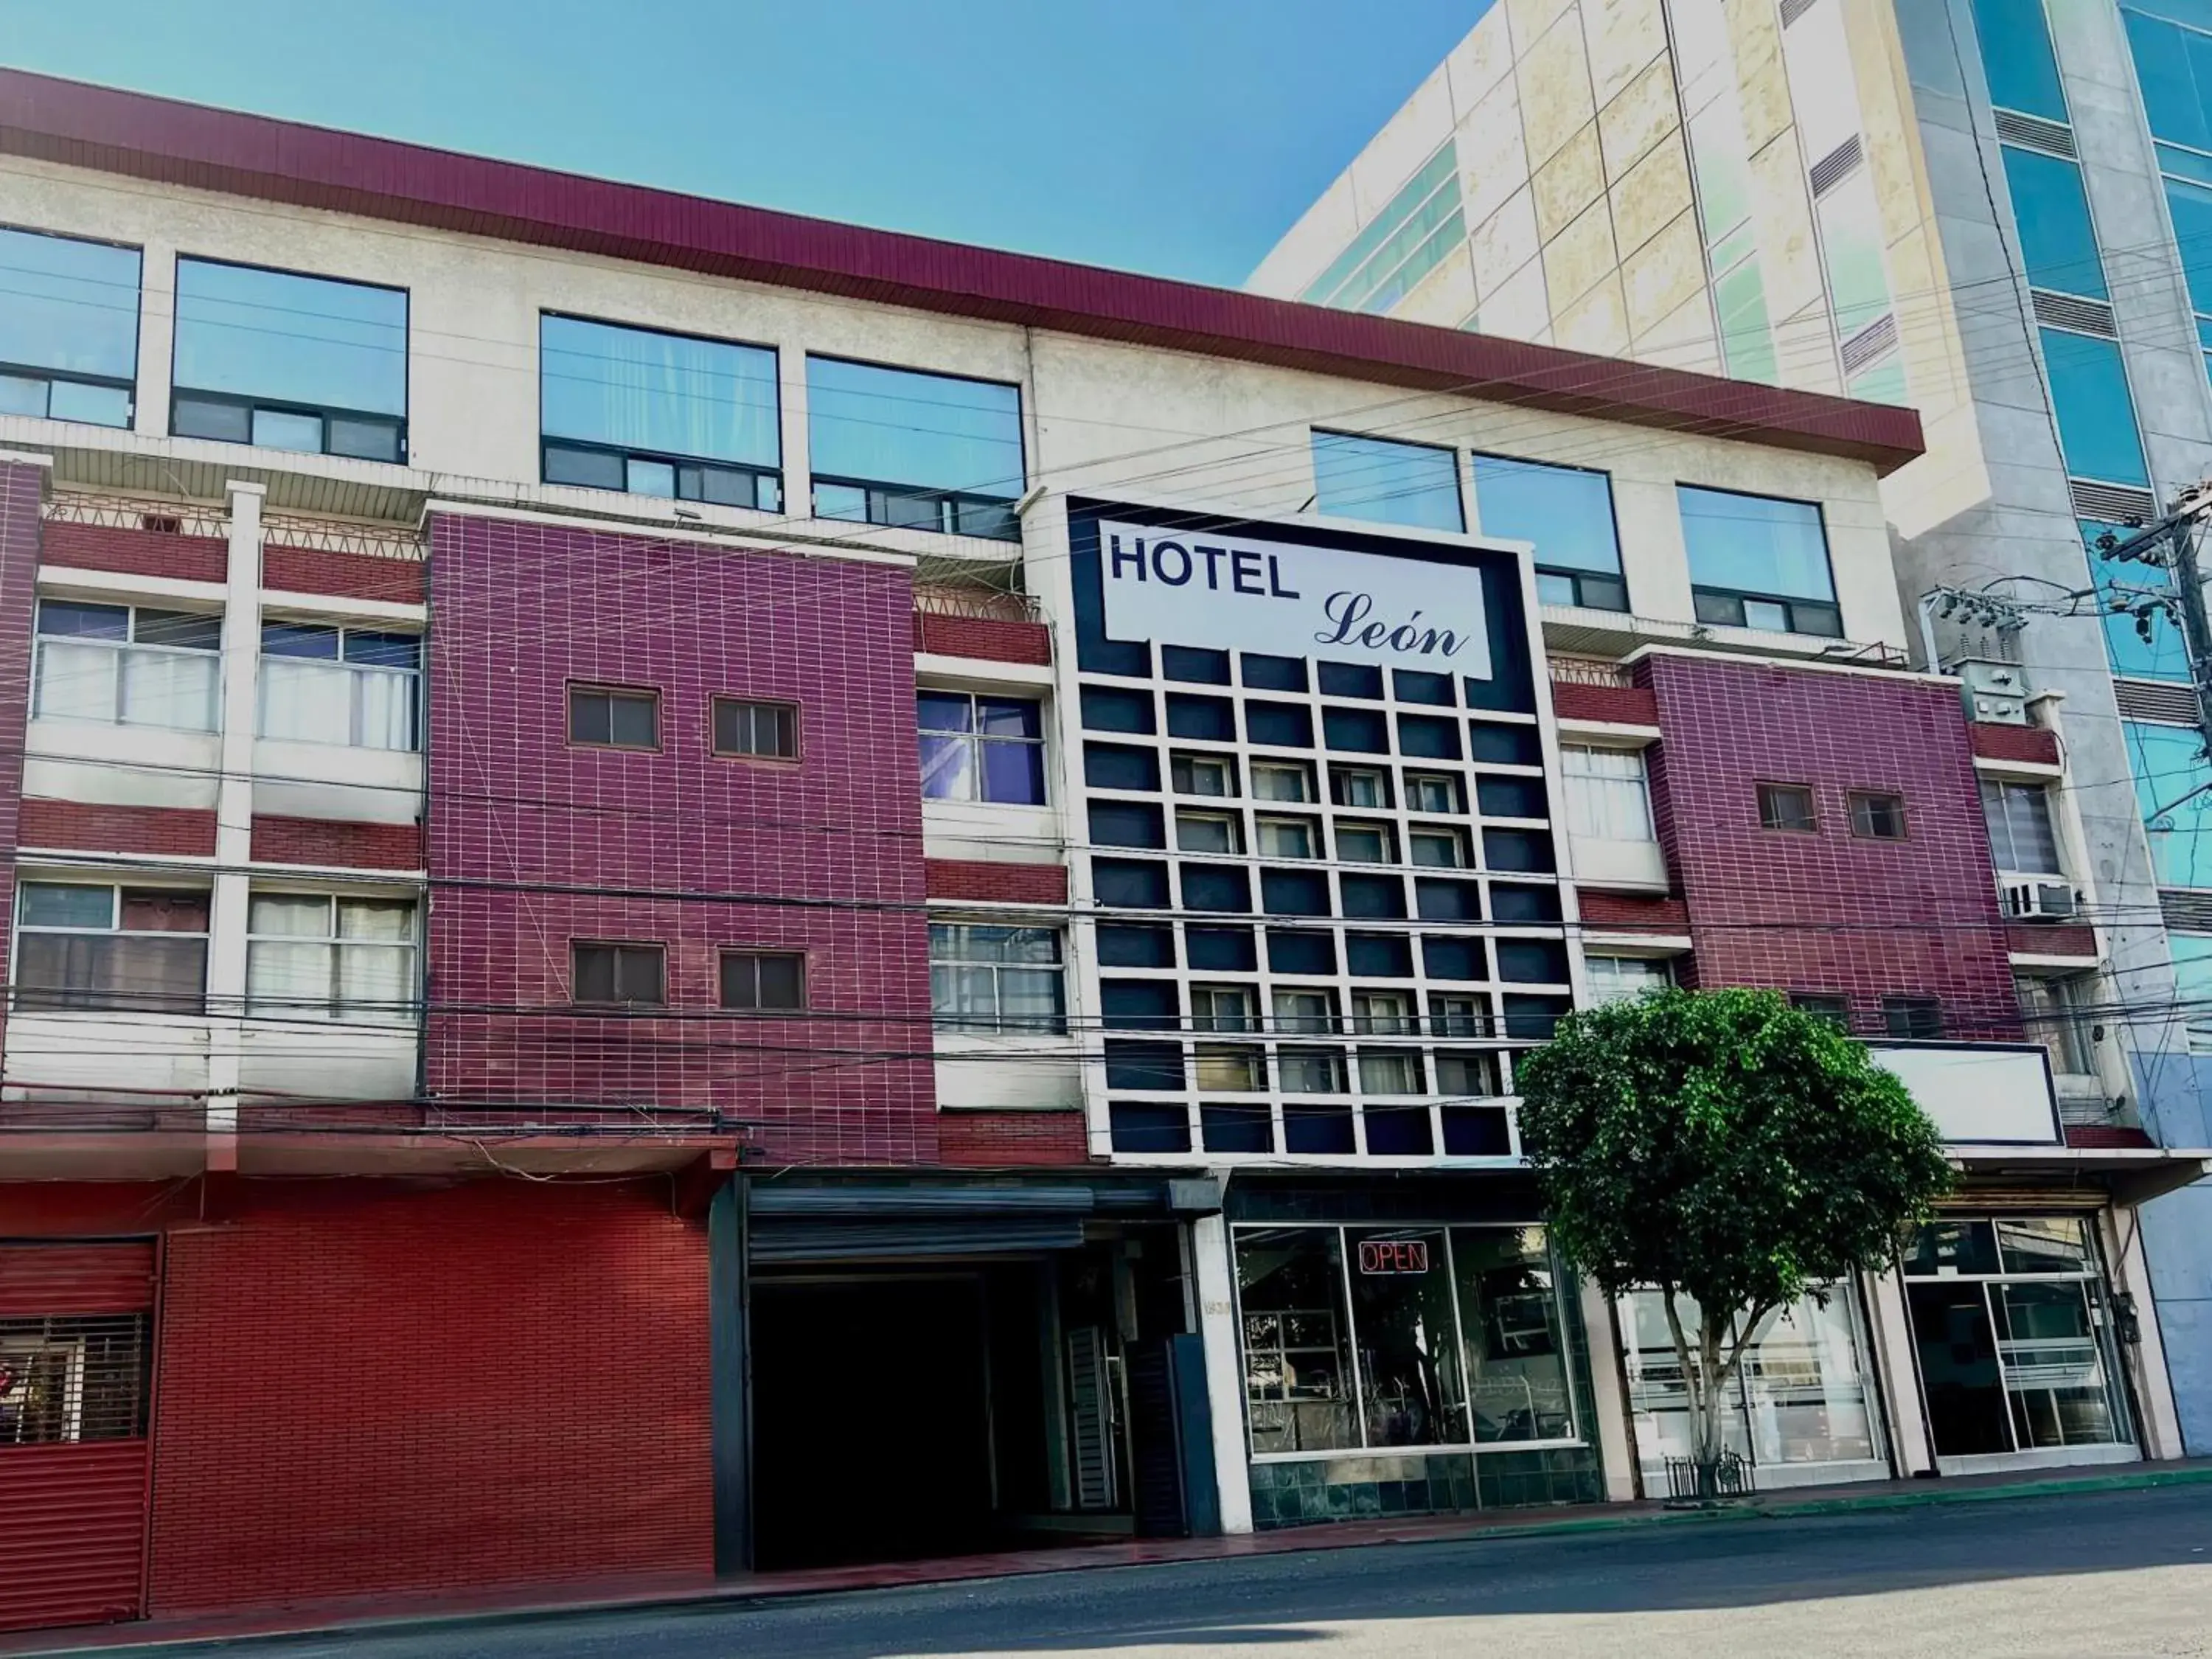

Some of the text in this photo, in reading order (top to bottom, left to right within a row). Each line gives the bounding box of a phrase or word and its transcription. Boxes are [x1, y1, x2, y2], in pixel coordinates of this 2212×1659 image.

[1110, 535, 1300, 599] HOTEL
[1314, 591, 1470, 657] León
[1362, 1243, 1425, 1270] OPEN
